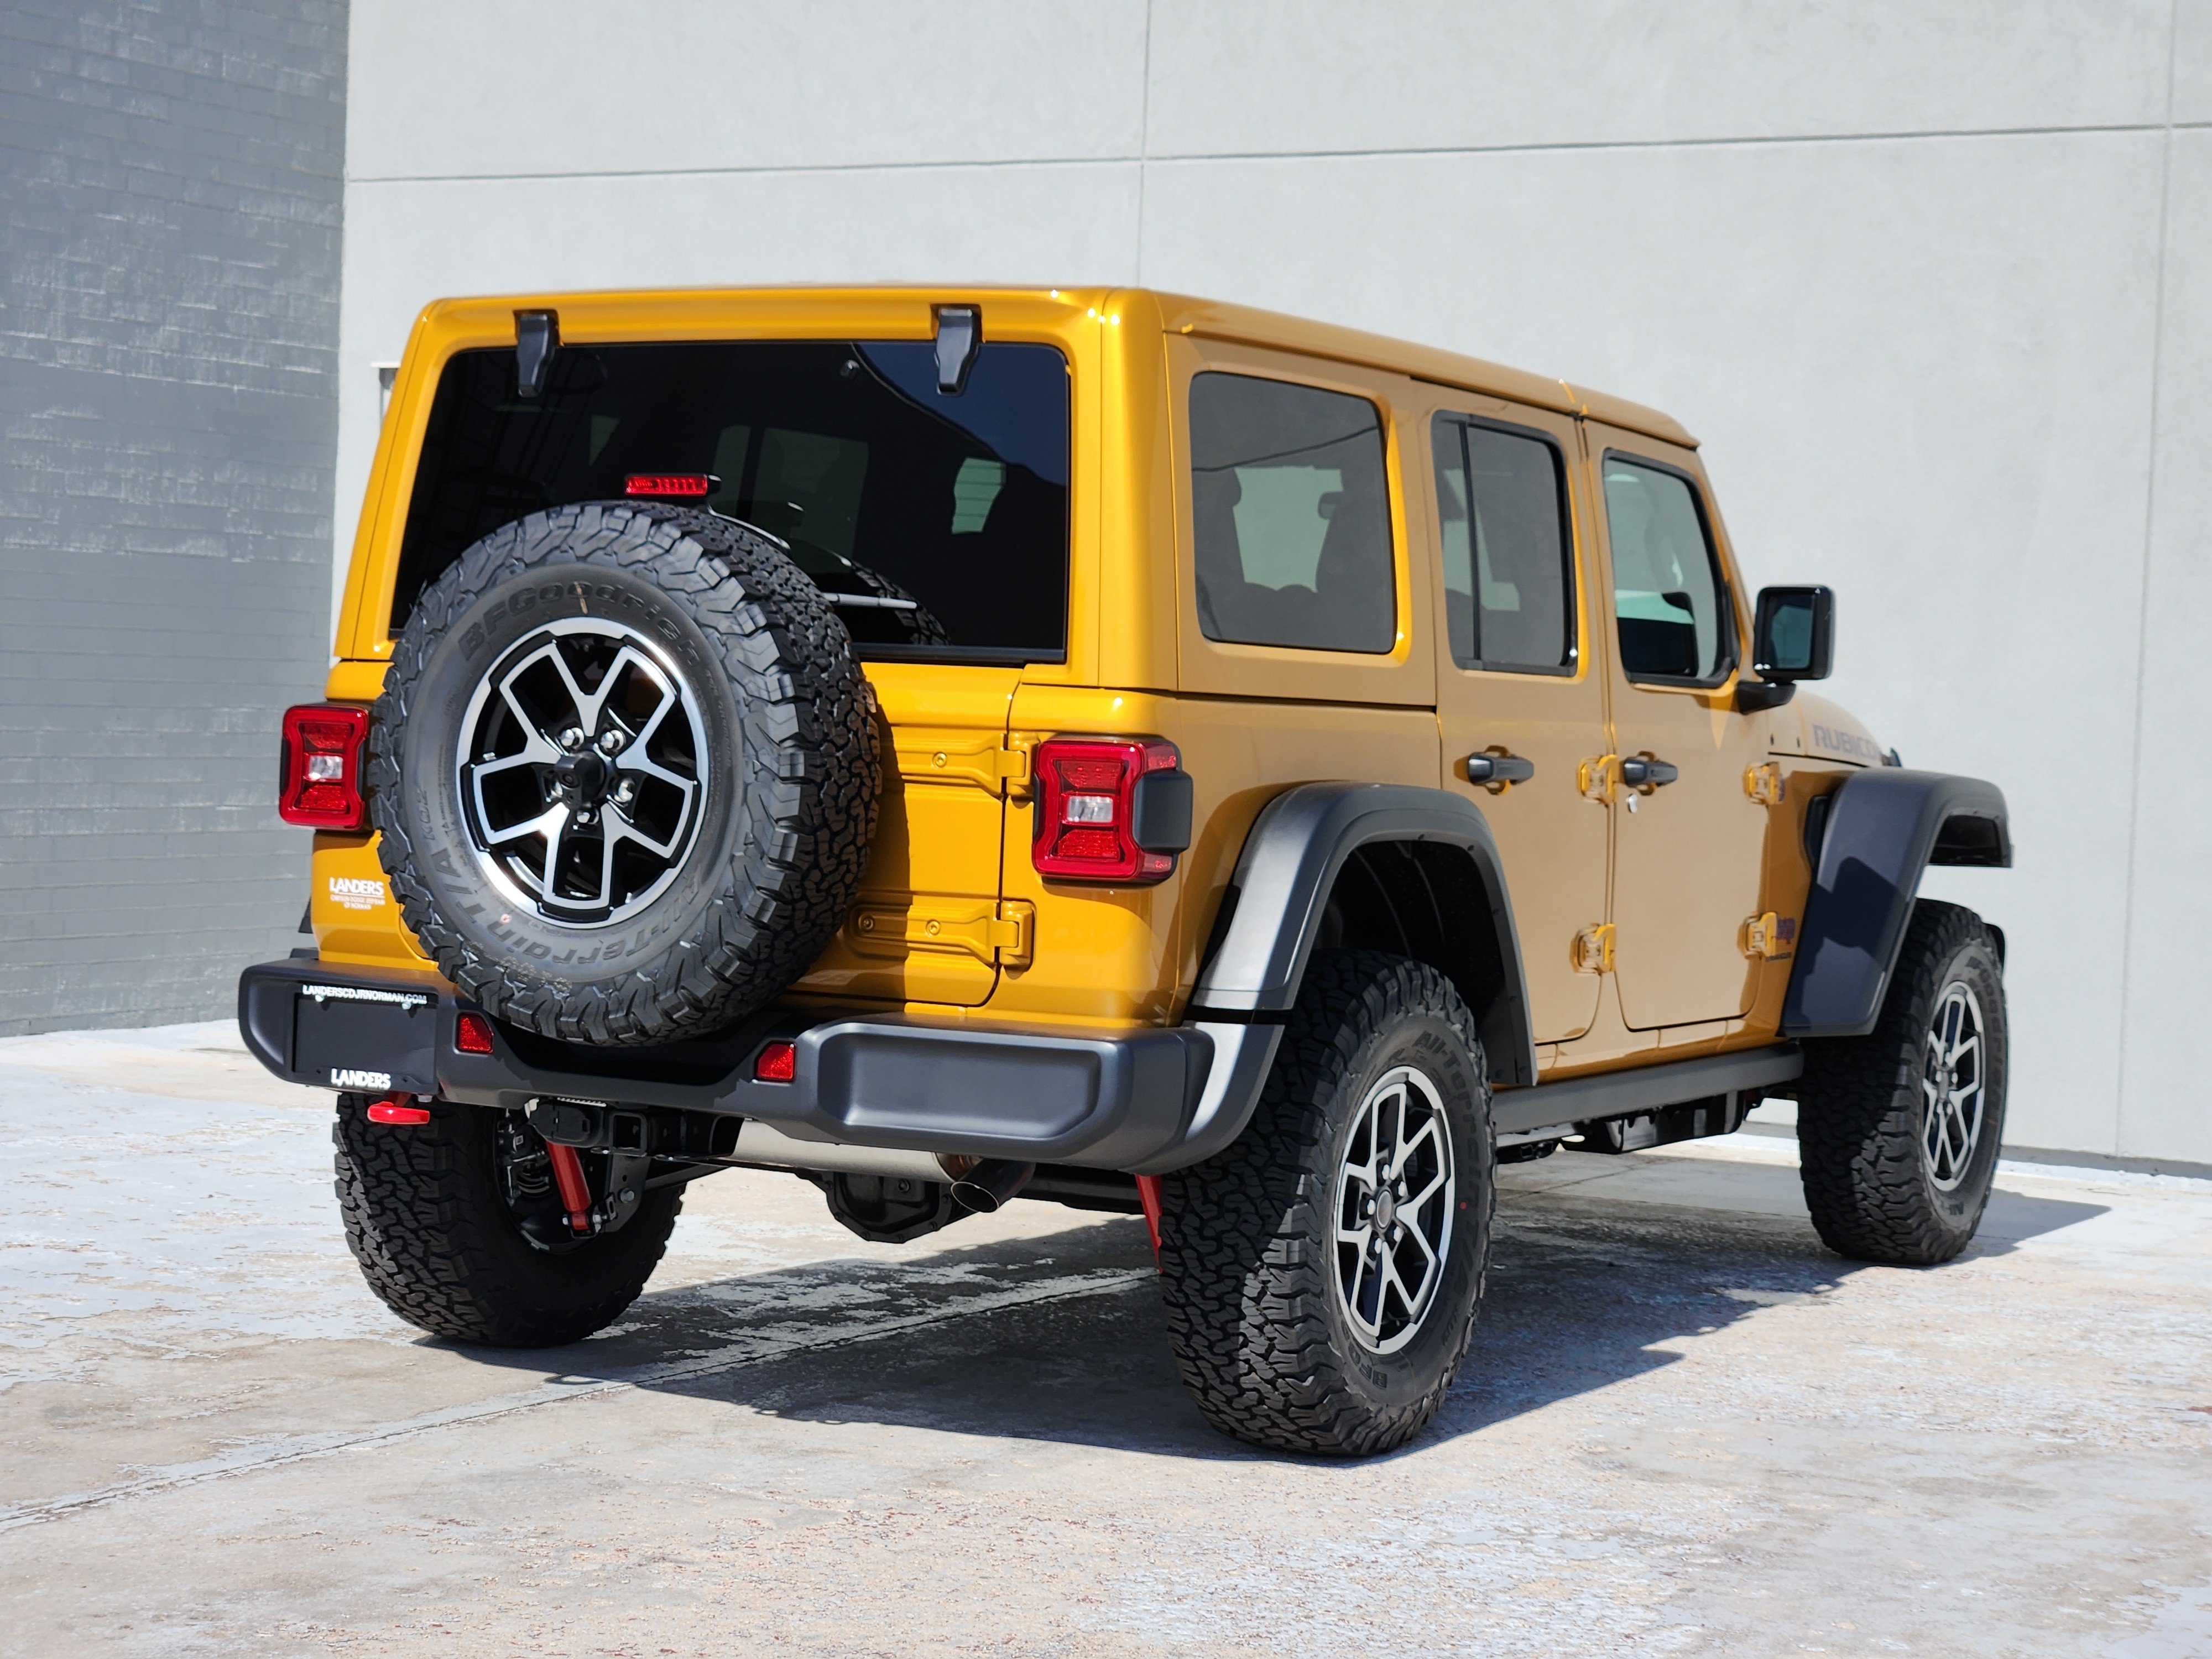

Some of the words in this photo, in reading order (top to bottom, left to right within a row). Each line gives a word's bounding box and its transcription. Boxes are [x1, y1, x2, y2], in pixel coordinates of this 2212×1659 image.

[458, 581, 701, 667] BFGoodrich
[1813, 723, 1879, 761] RUBICO
[330, 877, 384, 896] LANDERS
[430, 846, 486, 924] T/A
[487, 864, 701, 966] All-Terrain
[302, 984, 428, 1005] LANDERSCDJRNORMAN.COM
[331, 1068, 392, 1089] LANDERS
